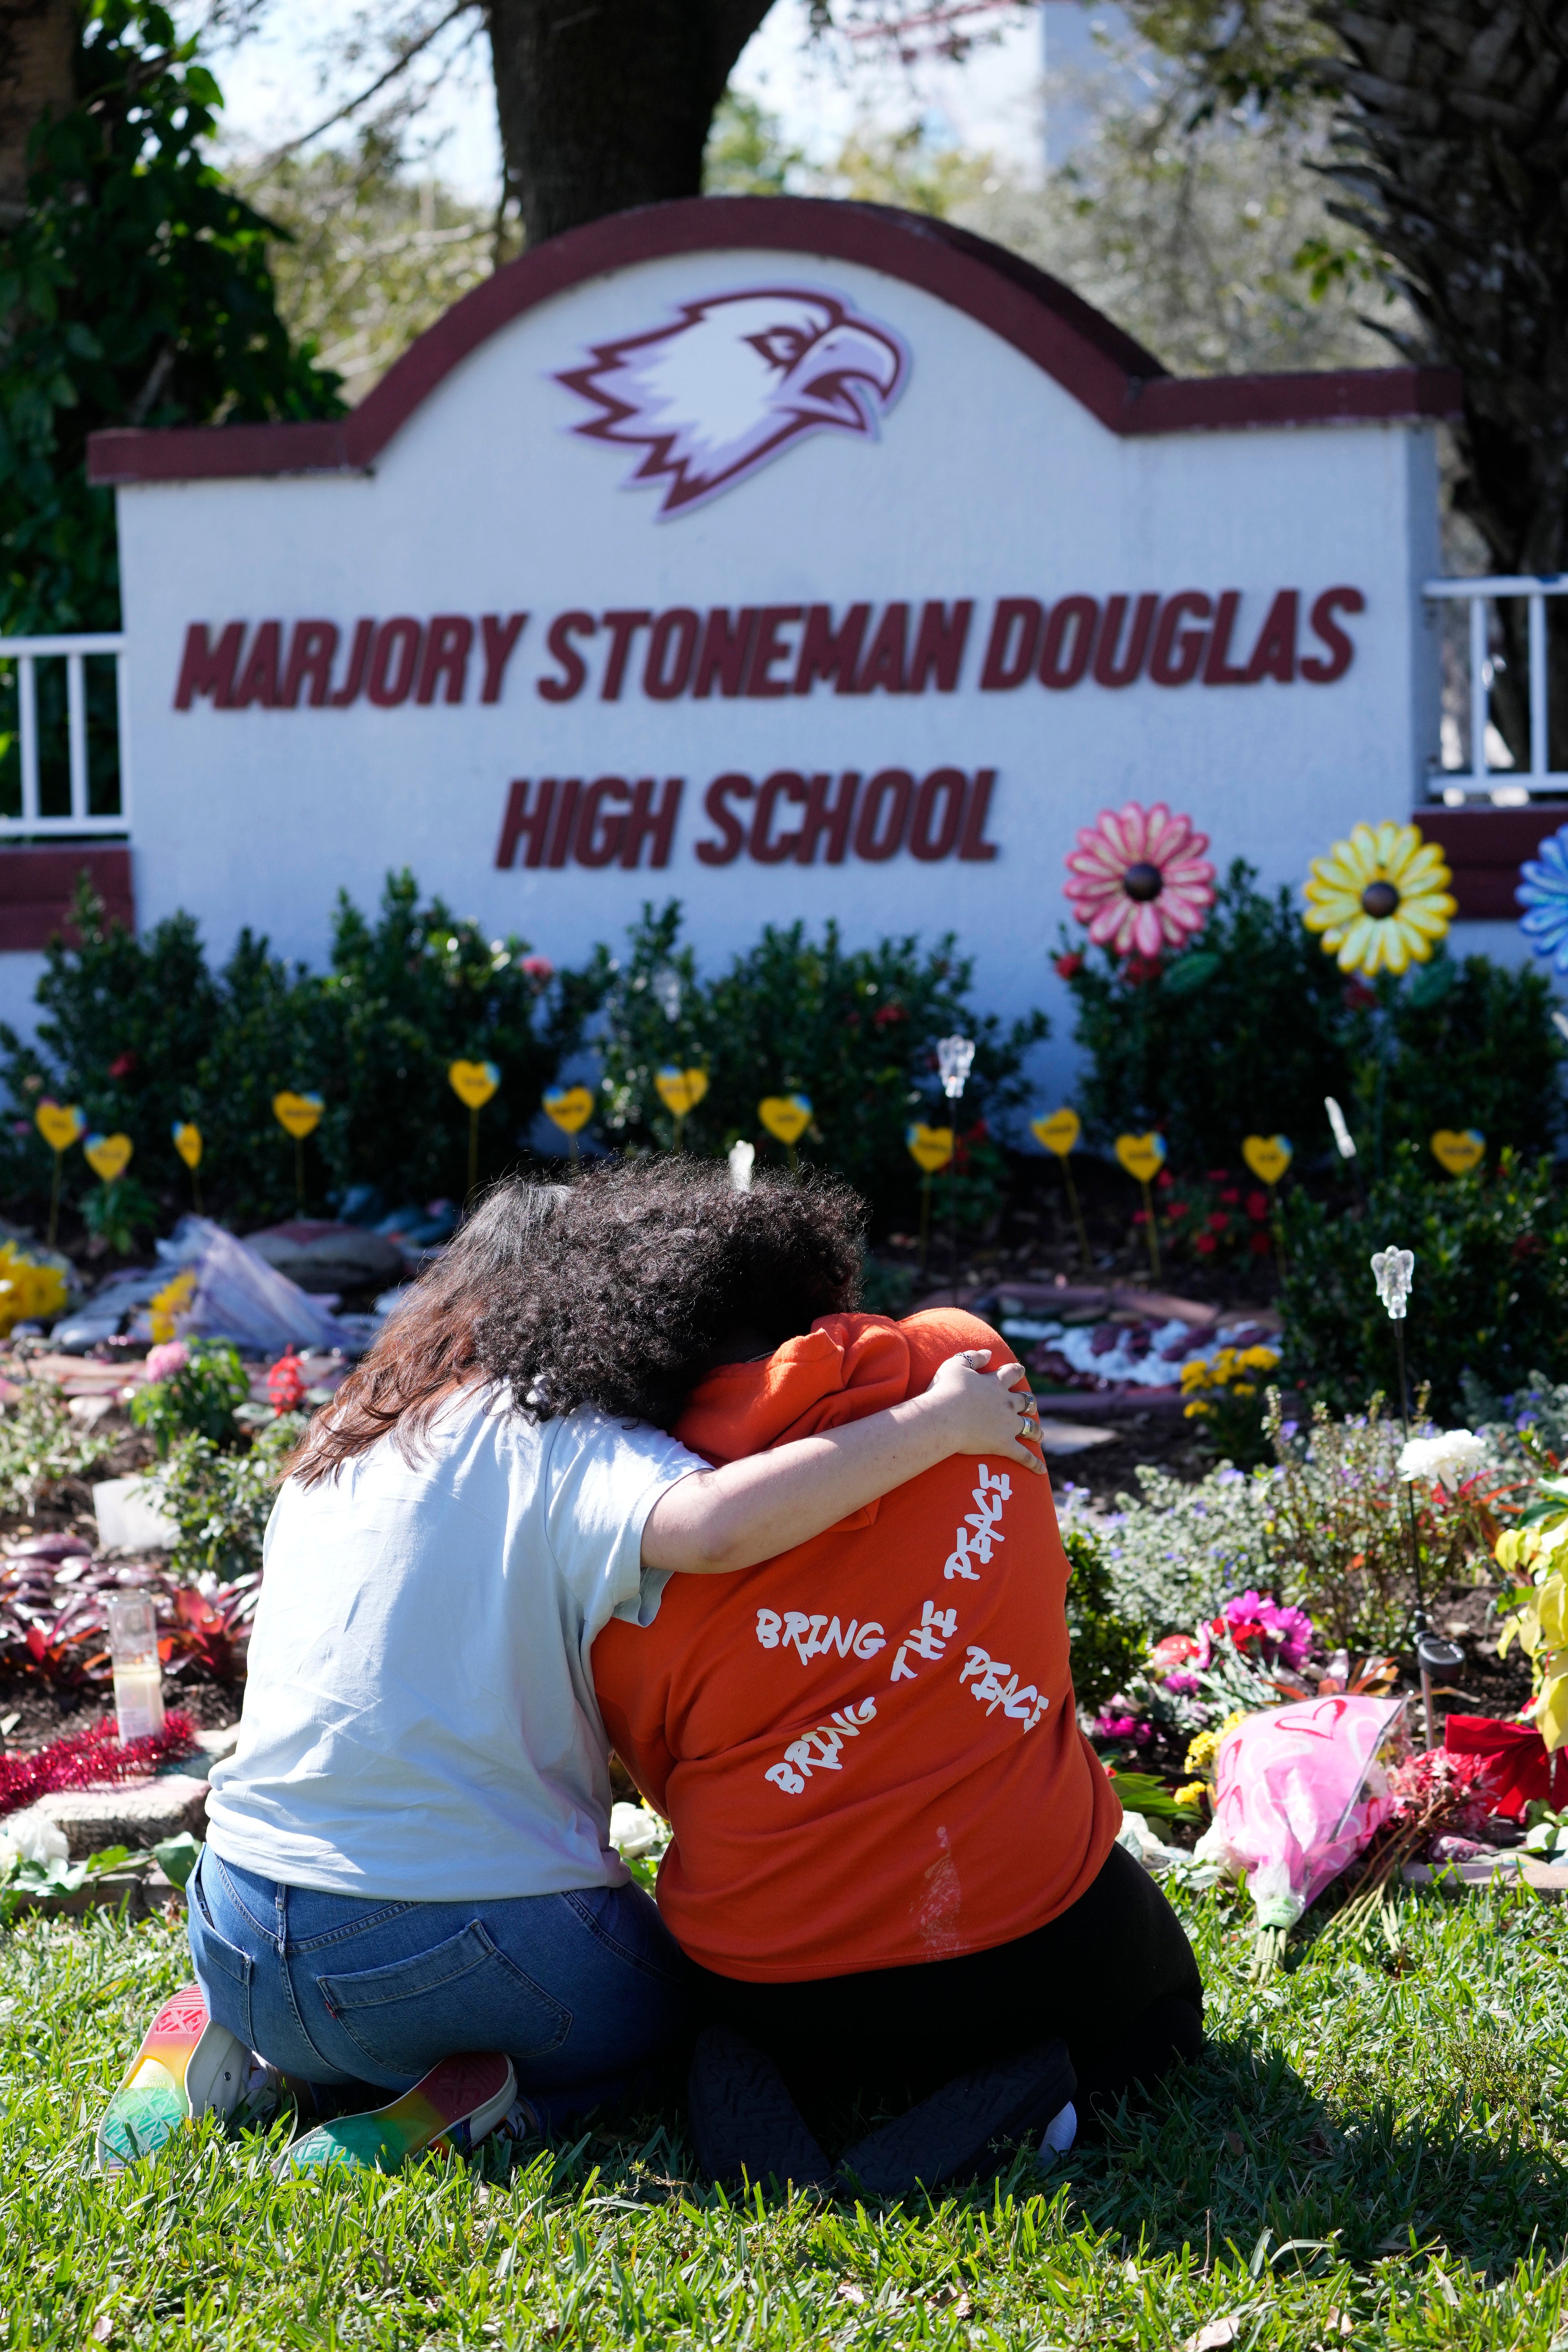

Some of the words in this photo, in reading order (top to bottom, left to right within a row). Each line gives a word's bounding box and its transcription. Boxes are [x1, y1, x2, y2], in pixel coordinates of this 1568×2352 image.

[173, 612, 530, 712] MARJORY
[536, 598, 973, 704] STONEMAN
[979, 585, 1366, 693] DOUGLAS
[494, 776, 685, 872] HIGH
[694, 766, 999, 868] SCHOOL
[756, 1608, 886, 1666] BRING
[959, 1646, 1049, 1733] PEACE
[765, 1697, 877, 1794] BRING
[890, 1600, 957, 1681] THE
[944, 1464, 1013, 1580] PEACE
